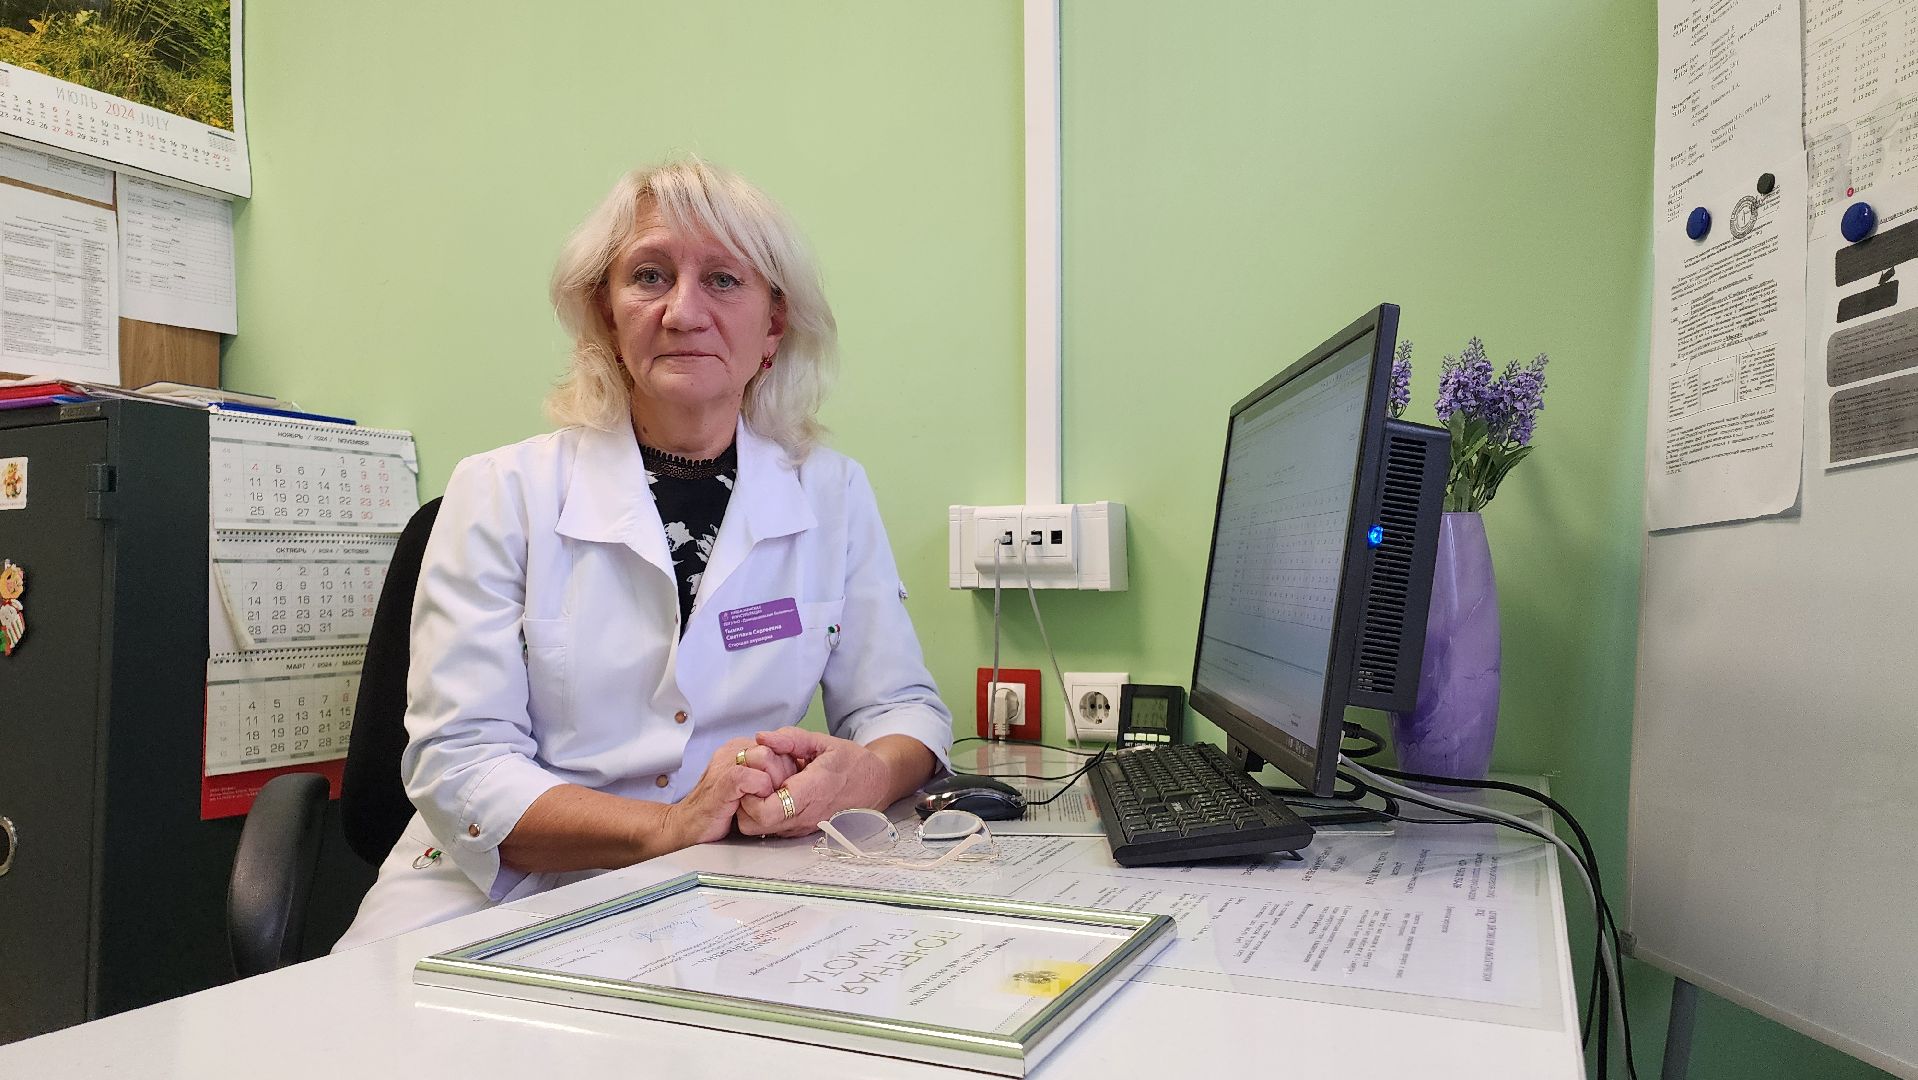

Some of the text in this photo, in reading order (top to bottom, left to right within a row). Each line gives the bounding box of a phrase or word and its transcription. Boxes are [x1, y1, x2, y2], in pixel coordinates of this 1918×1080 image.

[56, 87, 169, 131] ИЮЛЬ 2024 JULY
[360, 458, 365, 466] 2
[276, 465, 281, 473] 5
[298, 467, 304, 475] 6
[321, 468, 325, 476] 7
[341, 470, 347, 478] 8
[361, 471, 367, 480] 9
[378, 473, 388, 481] 10
[250, 478, 389, 494] 11 12 13 14 15 16 17
[250, 492, 263, 501] 18
[274, 493, 286, 502] 19
[296, 494, 309, 503] 20
[318, 496, 329, 504] 21
[339, 497, 351, 505] 22
[360, 498, 371, 506] 23
[250, 507, 373, 519] 25 26 27 28 29 30
[276, 567, 281, 575] 1
[300, 567, 306, 575] 2
[323, 567, 328, 576] 3
[364, 567, 370, 576] 5
[252, 581, 373, 590] 7 8 9 10 11 12
[248, 594, 374, 605] 14 15 16 17 18 19
[248, 608, 375, 620] 21 22 23 24 25 26
[248, 623, 331, 635] 28 29 30 31
[726, 624, 781, 640] Светлана Сергеевна
[728, 635, 773, 648] Старшая акушерка
[274, 699, 280, 708] 5
[299, 697, 304, 706] 6
[323, 695, 328, 704] 7
[247, 707, 350, 726] 11 12 13 14 15
[247, 721, 350, 740] 18 19 20 21 22
[246, 746, 259, 756] 25
[271, 743, 284, 752] 26
[295, 740, 308, 750] 27
[319, 737, 332, 747] 28
[787, 929, 918, 984] ГРАМОТА
[831, 930, 963, 995] ПОЧЕТНАЯ
